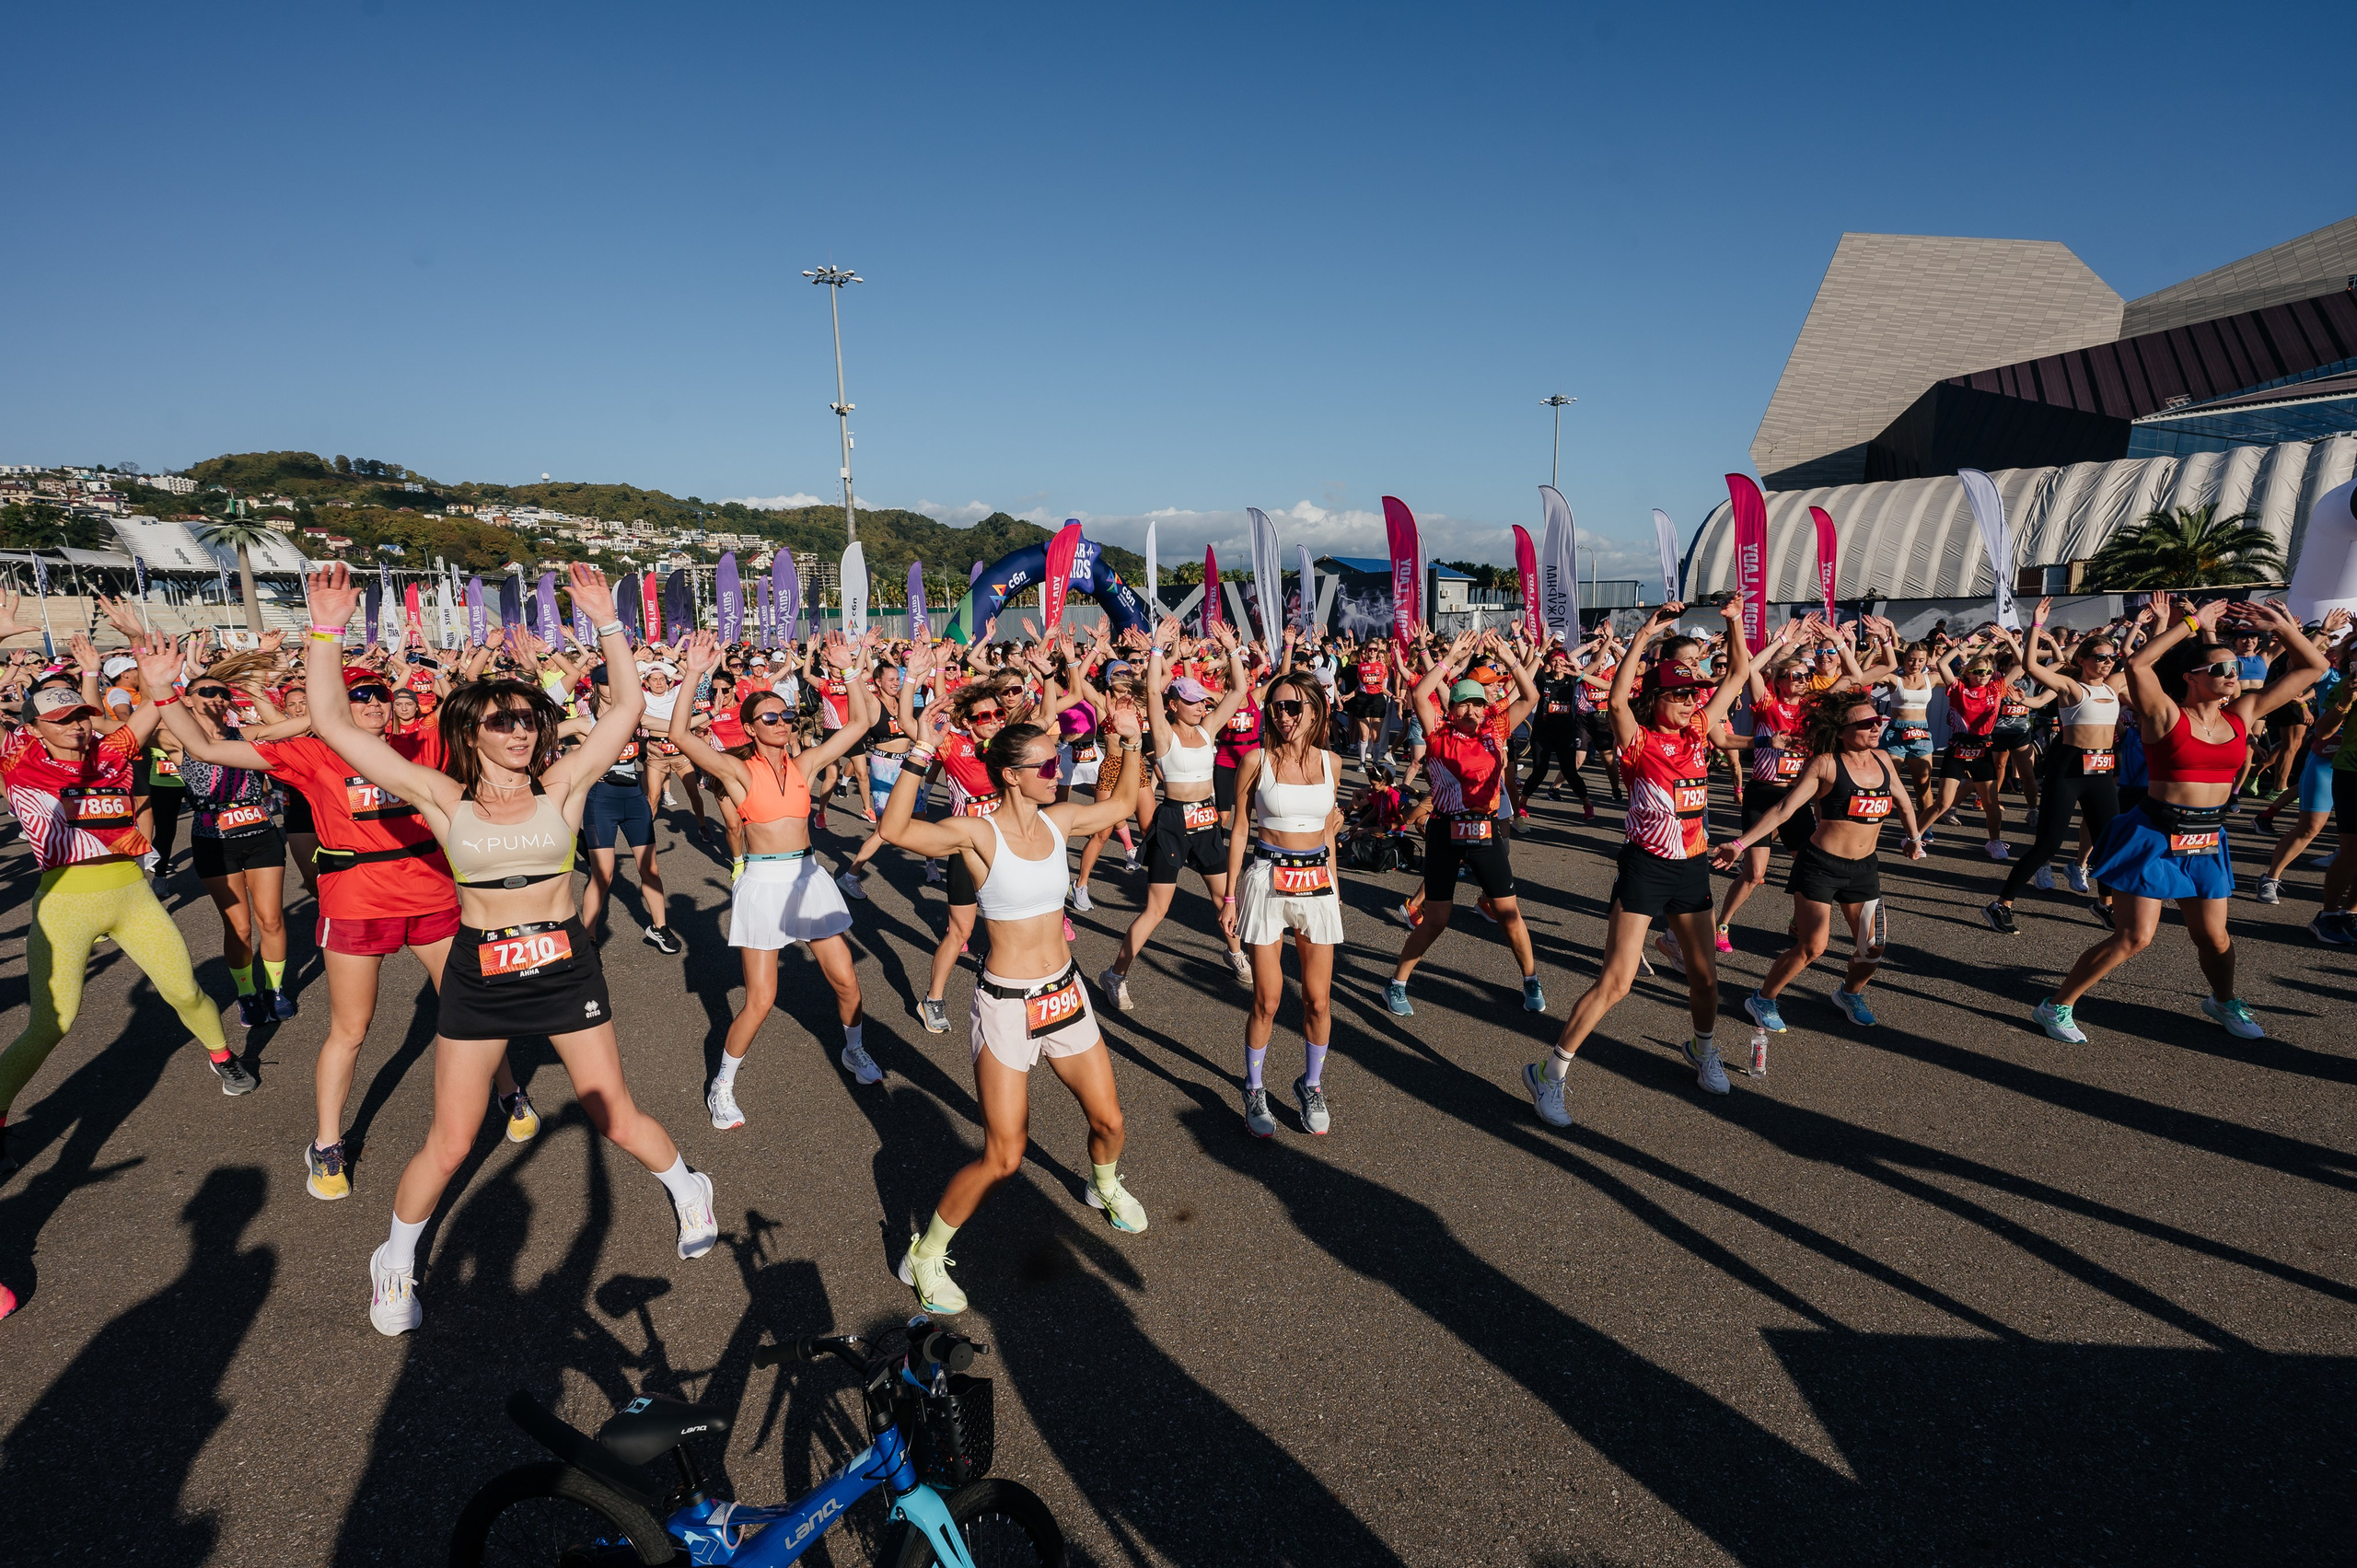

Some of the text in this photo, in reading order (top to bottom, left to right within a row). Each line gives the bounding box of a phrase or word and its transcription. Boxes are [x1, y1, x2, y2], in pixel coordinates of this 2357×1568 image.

[1008, 571, 1027, 589] сбп
[1122, 586, 1136, 606] сбп
[578, 627, 587, 645] STAR
[649, 621, 657, 637] IRON
[778, 622, 786, 640] TAR
[2006, 705, 2026, 714] 7387
[1906, 729, 1925, 738] 7601
[1075, 749, 1094, 759] 7780
[1959, 749, 1981, 757] 7657
[2091, 756, 2112, 767] 7591
[1682, 789, 1704, 807] 7929
[1857, 799, 1888, 813] 7260
[74, 797, 124, 816] 7866
[223, 807, 262, 824] 7064
[1193, 810, 1214, 823] 7632
[1458, 823, 1486, 836] 7189
[488, 833, 556, 853] PUMA
[2178, 833, 2211, 846] 7821
[1284, 870, 1318, 889] 7711
[493, 936, 555, 967] 7210
[519, 969, 540, 977] АННА
[1038, 987, 1078, 1020] 7996
